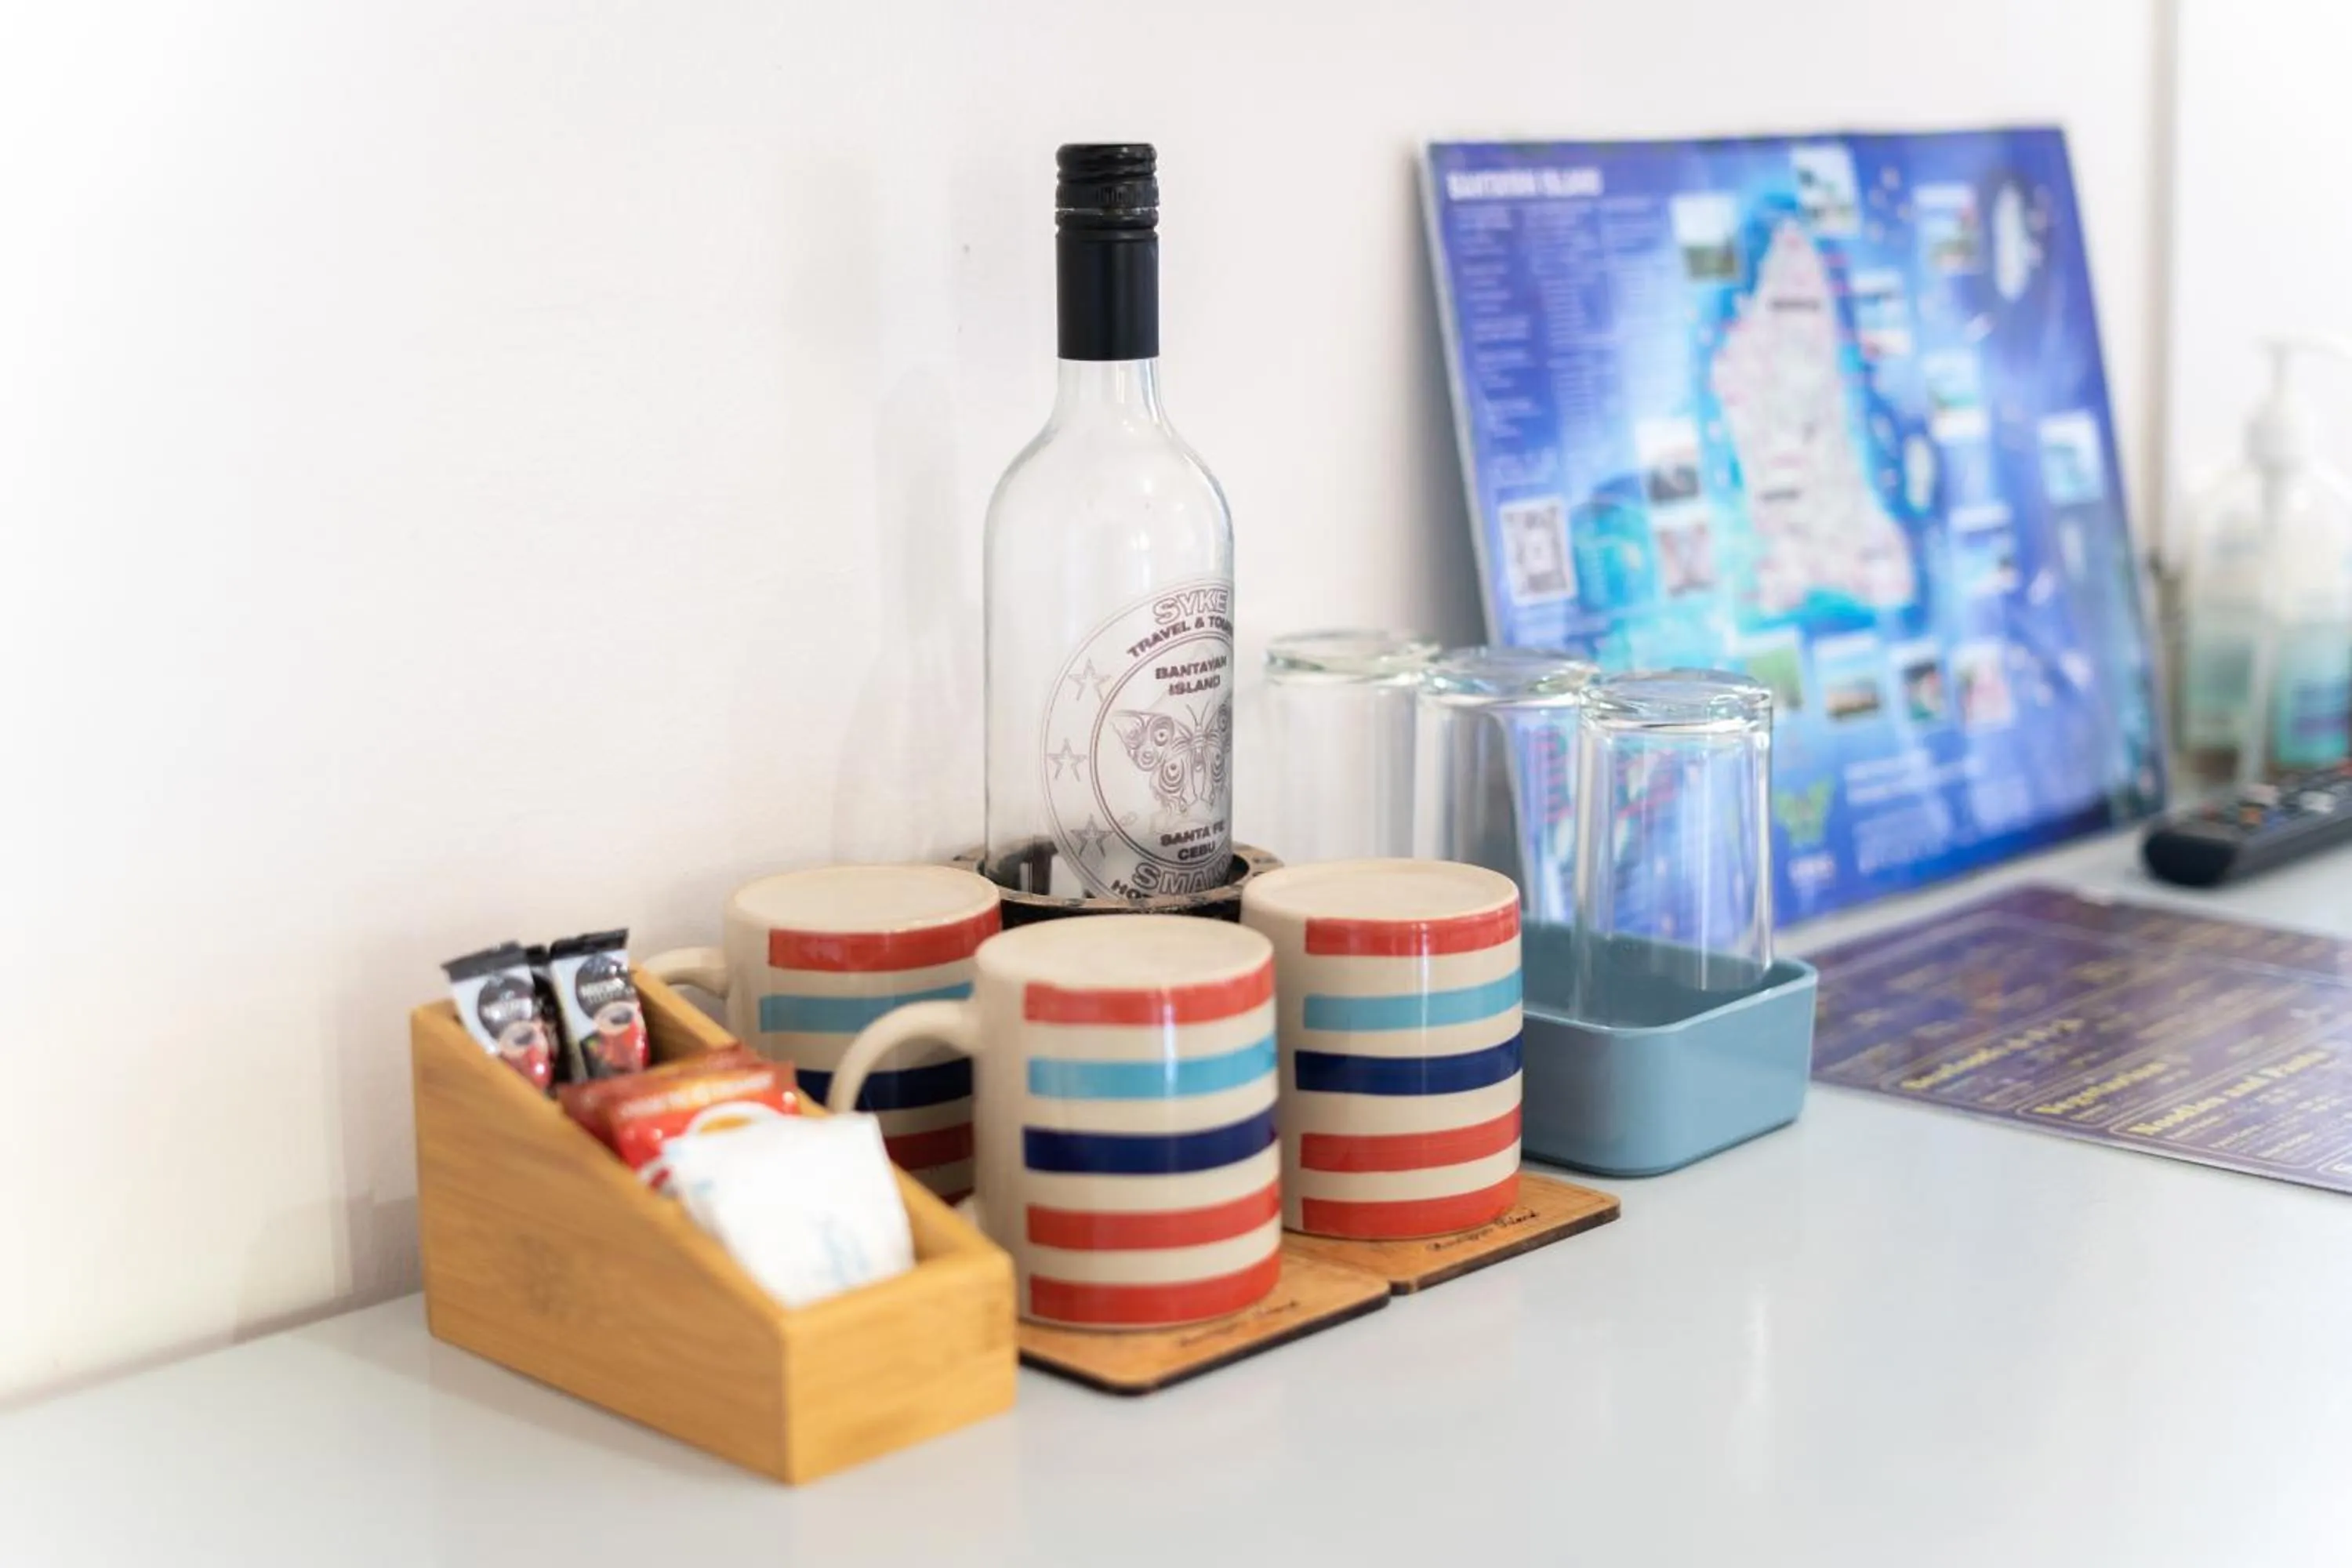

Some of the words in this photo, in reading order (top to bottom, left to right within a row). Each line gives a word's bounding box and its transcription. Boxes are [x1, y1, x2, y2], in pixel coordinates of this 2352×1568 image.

[1127, 621, 1191, 657] TRAVEL
[1195, 617, 1205, 629] &
[1156, 655, 1227, 679] BANTAYAN
[1168, 675, 1221, 695] ISLAND
[1160, 826, 1210, 846] SANTA
[1178, 841, 1216, 860] CEBU
